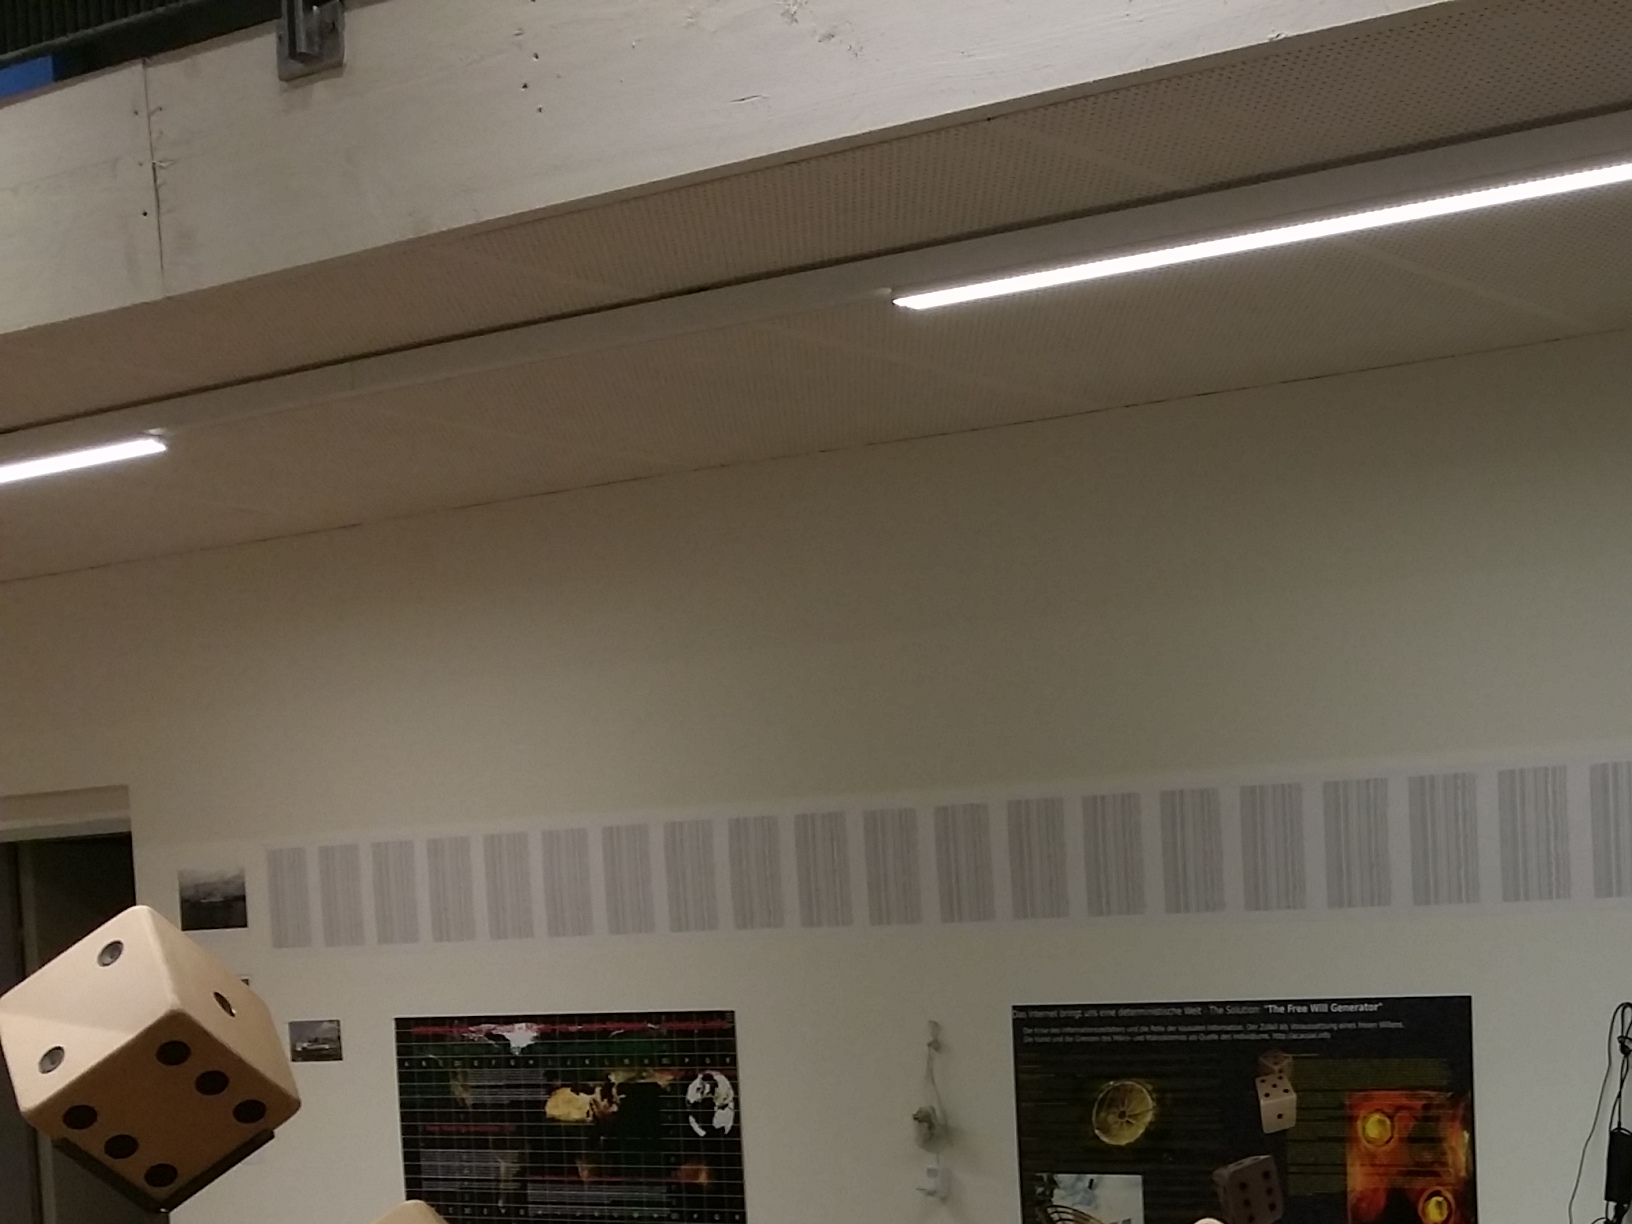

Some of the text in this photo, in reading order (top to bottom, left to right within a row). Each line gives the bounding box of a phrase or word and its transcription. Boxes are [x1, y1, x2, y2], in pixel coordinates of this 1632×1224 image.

[1209, 1005, 1224, 1015] The
[1264, 1004, 1285, 1013] "The
[1287, 1004, 1307, 1013] Free
[1310, 1003, 1328, 1012] Will
[1330, 1002, 1383, 1012] Generator"
